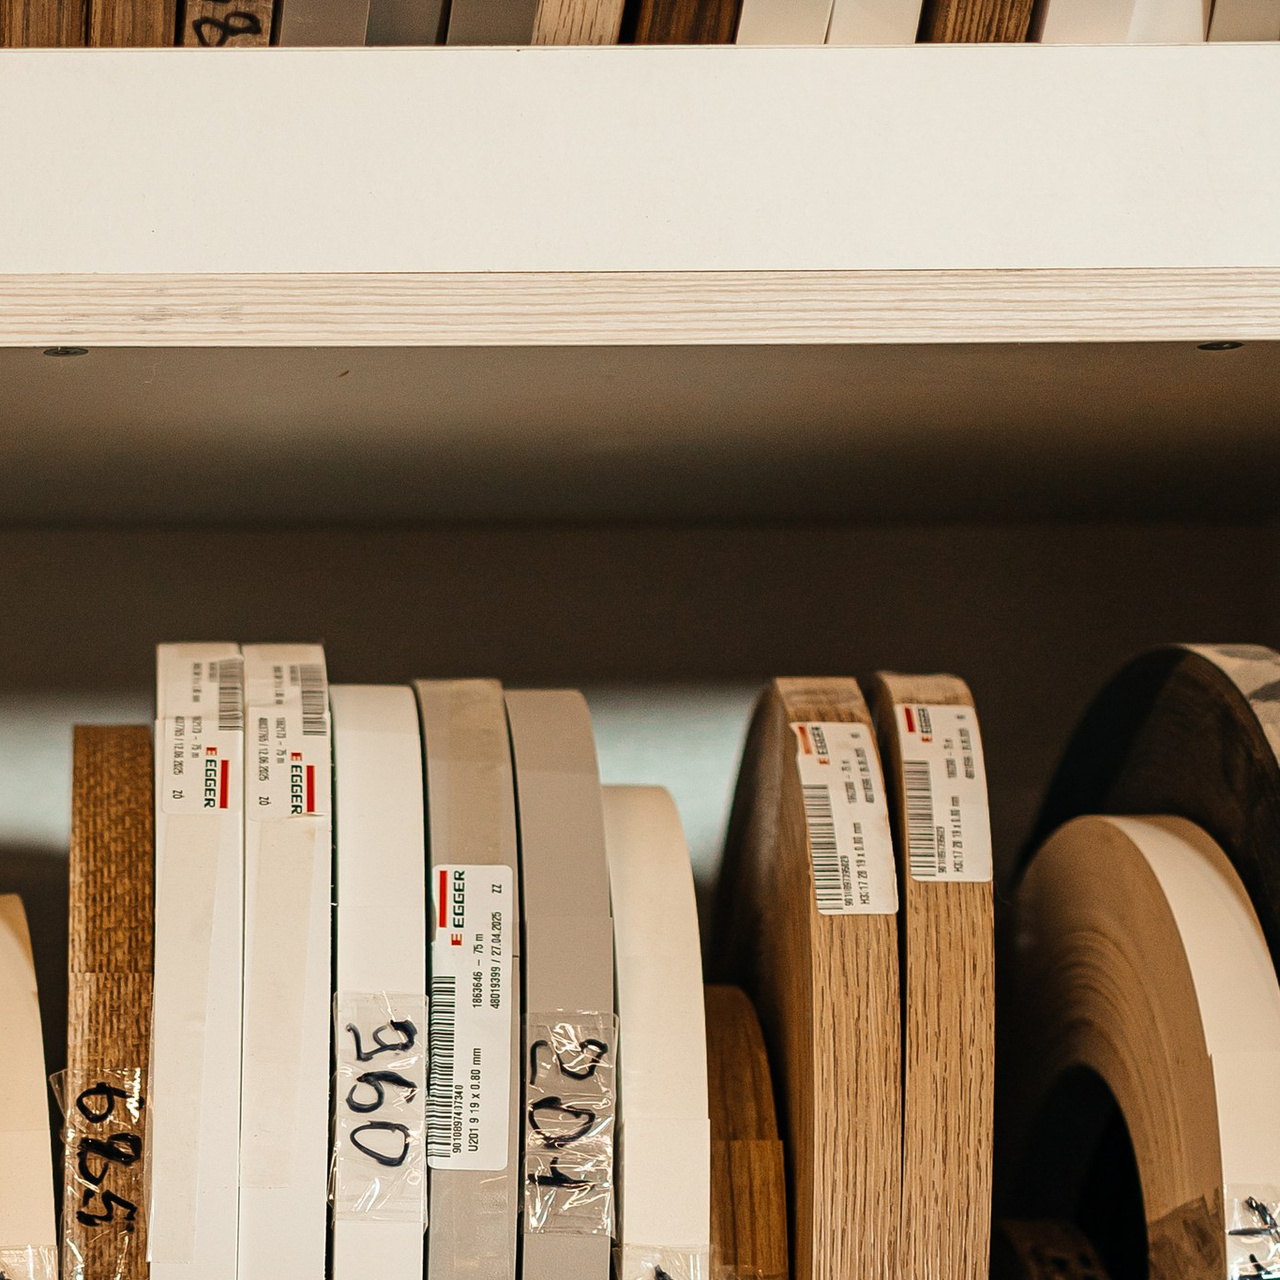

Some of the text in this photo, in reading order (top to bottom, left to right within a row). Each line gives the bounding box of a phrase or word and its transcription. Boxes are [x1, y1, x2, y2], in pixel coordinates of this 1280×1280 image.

[203, 747, 218, 808] E EGGER
[290, 752, 303, 815] E EGGER
[450, 870, 466, 946] E EGGER
[472, 933, 484, 1008] 1863646 75 m
[490, 884, 502, 1010] 48019399 27.04.2025 ZZ
[469, 1069, 481, 1090] 0.80
[471, 1048, 481, 1065] mm
[347, 1020, 418, 1167] 960
[469, 1102, 480, 1113] 19
[528, 1039, 608, 1187] 201
[76, 1083, 145, 1228] 685
[468, 1127, 479, 1152] U201
